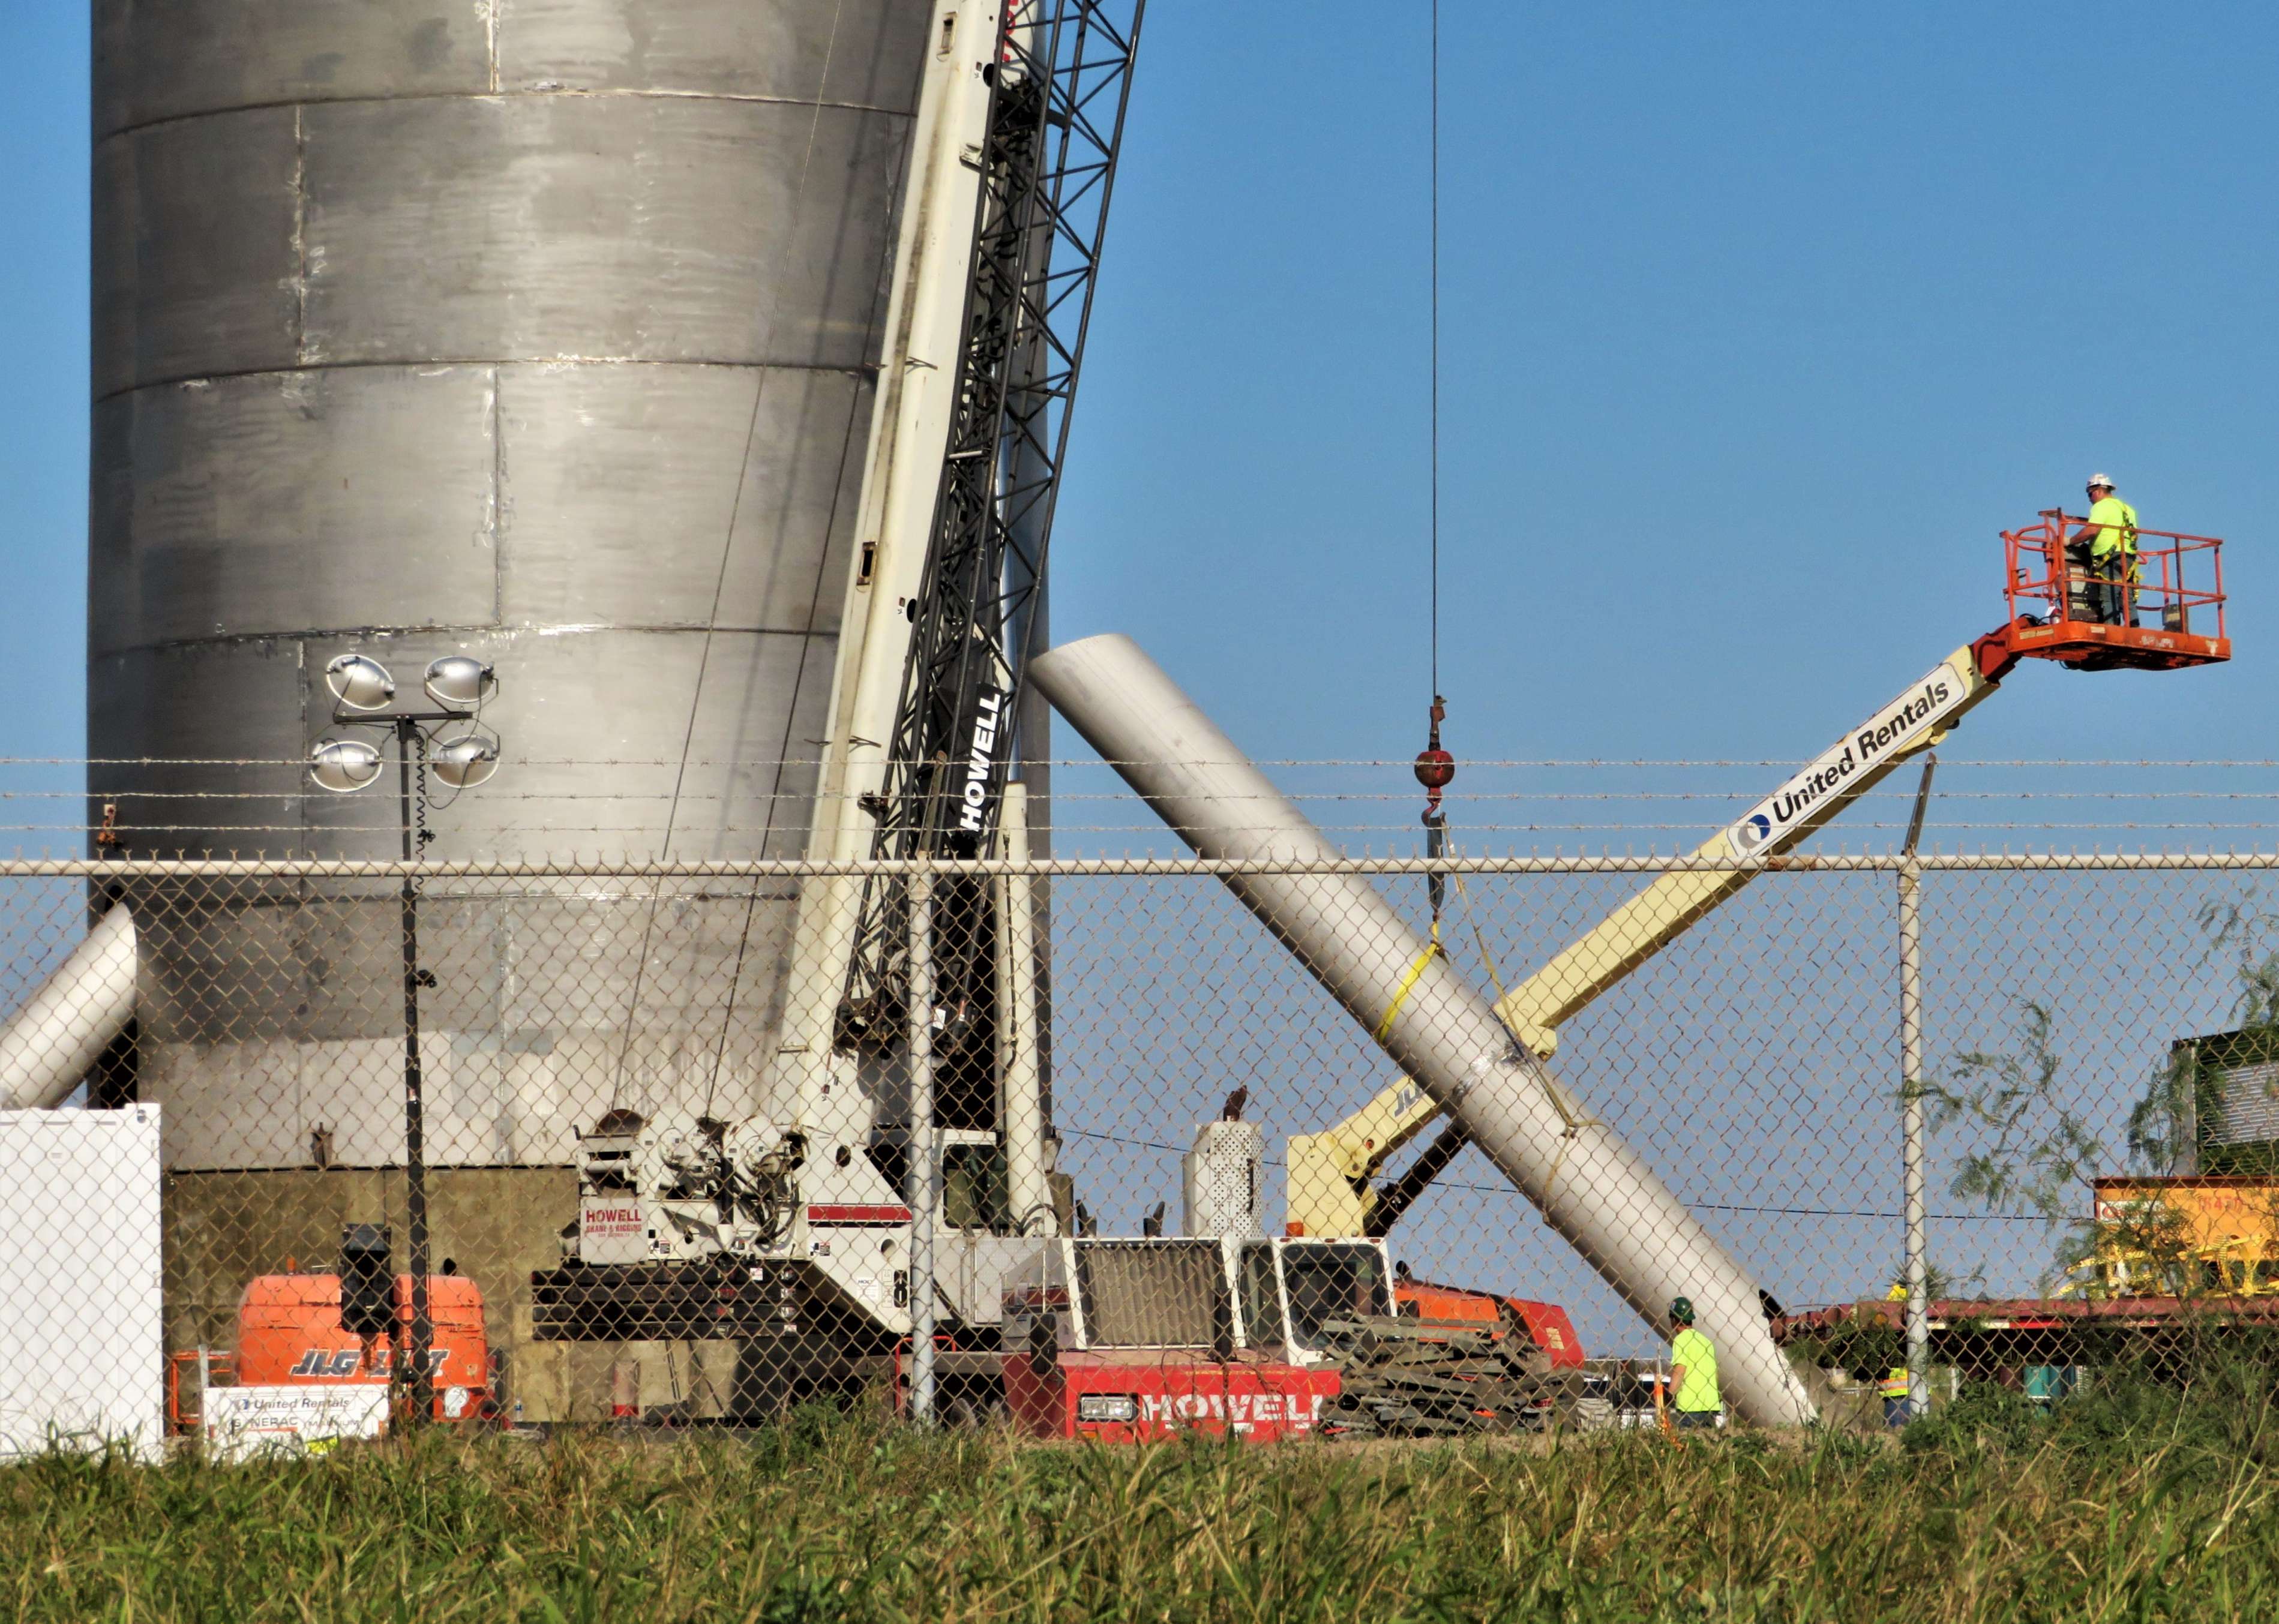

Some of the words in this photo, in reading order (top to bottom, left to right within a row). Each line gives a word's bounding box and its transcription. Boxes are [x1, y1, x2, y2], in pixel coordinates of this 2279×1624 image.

[1773, 746, 1855, 822] United
[1857, 682, 1949, 760] Rentals
[960, 694, 1000, 832] HOWELL
[586, 1209, 642, 1223] HOWELL
[289, 1349, 359, 1377] JLG
[254, 1398, 298, 1409] United
[231, 1416, 298, 1428] GNERAC
